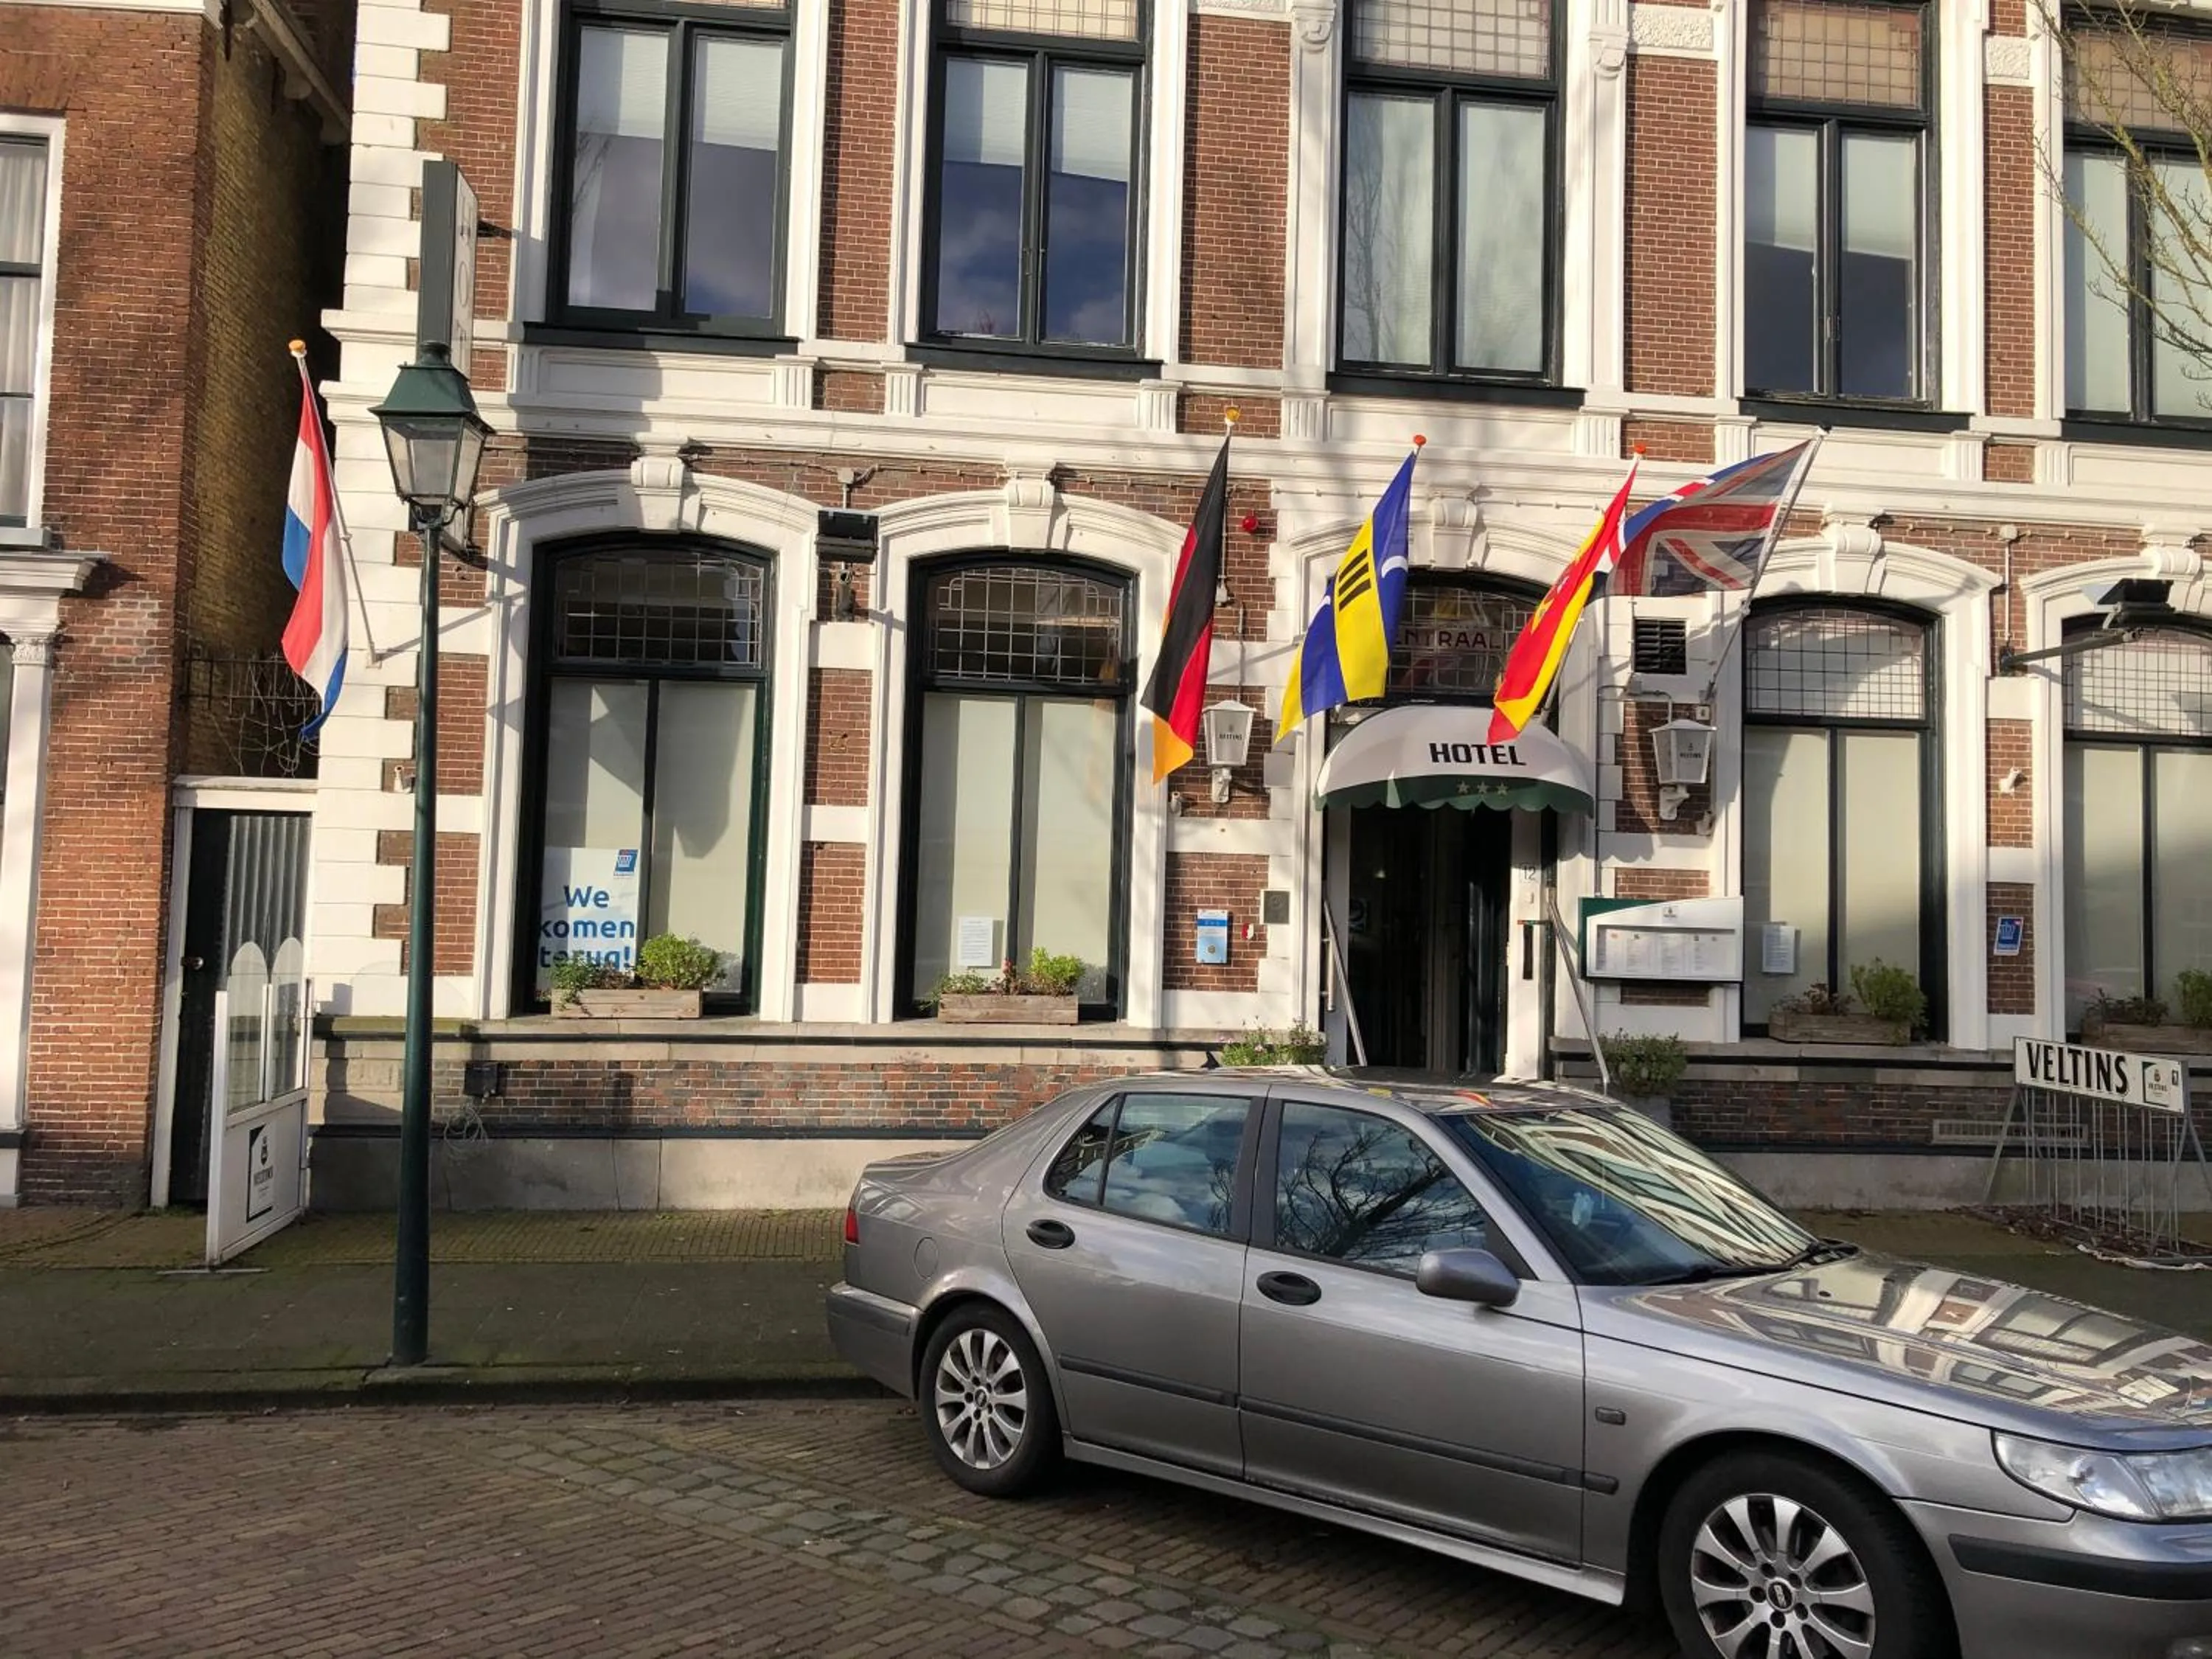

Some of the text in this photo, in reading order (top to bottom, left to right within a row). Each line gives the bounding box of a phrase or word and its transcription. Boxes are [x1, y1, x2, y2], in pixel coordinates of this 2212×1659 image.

[1396, 628, 1501, 649] NTRAAL
[1429, 742, 1527, 766] HOTEL
[1524, 866, 1536, 880] 12
[563, 886, 610, 908] We
[2026, 1042, 2129, 1094] VELTINS
